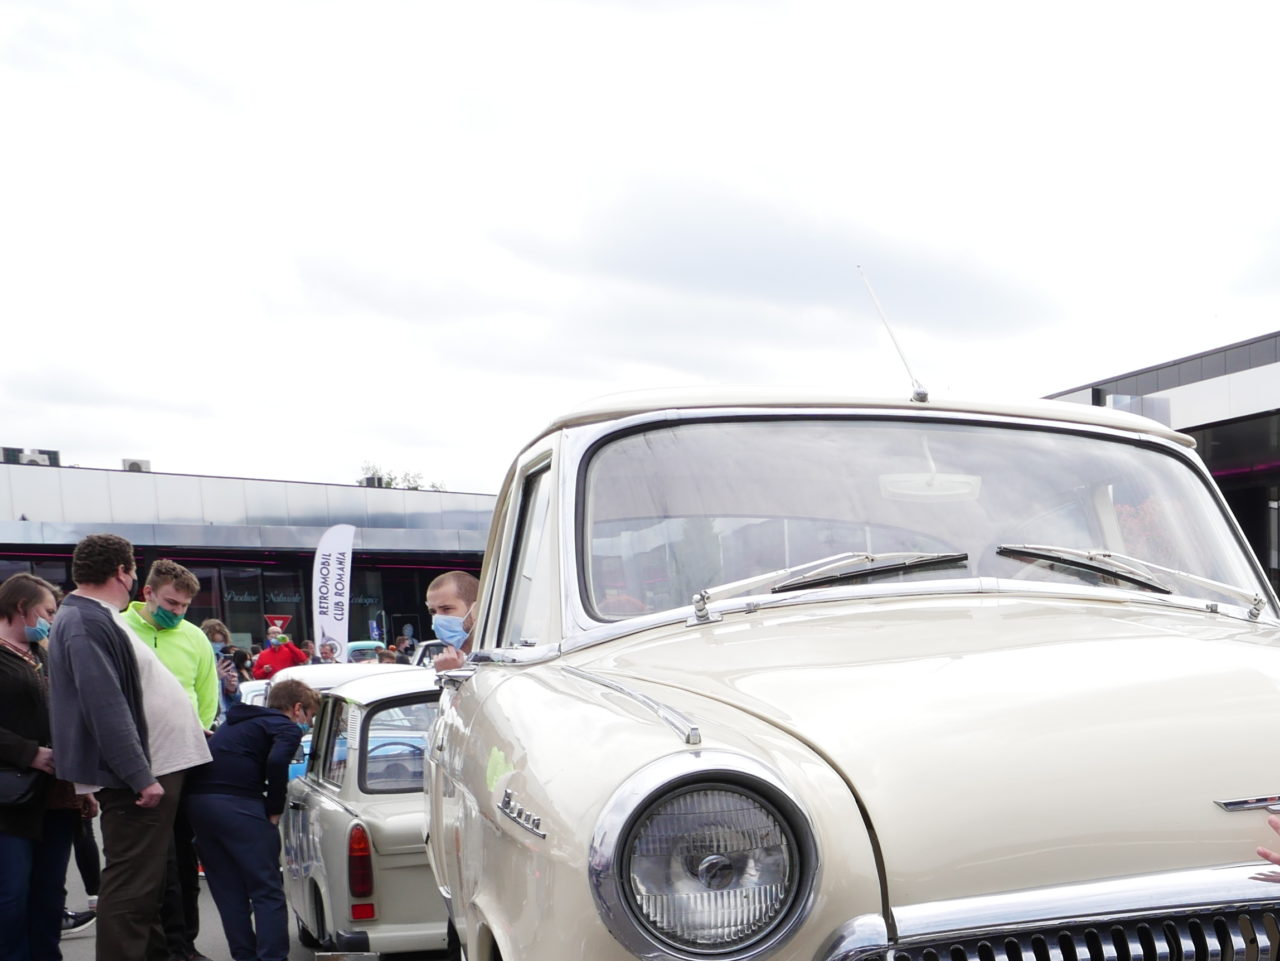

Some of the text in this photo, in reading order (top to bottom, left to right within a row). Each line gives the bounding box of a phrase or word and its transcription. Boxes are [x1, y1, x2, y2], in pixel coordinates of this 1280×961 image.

[319, 553, 331, 616] RETROMOBIL
[333, 551, 347, 622] CLUB ROMANIA
